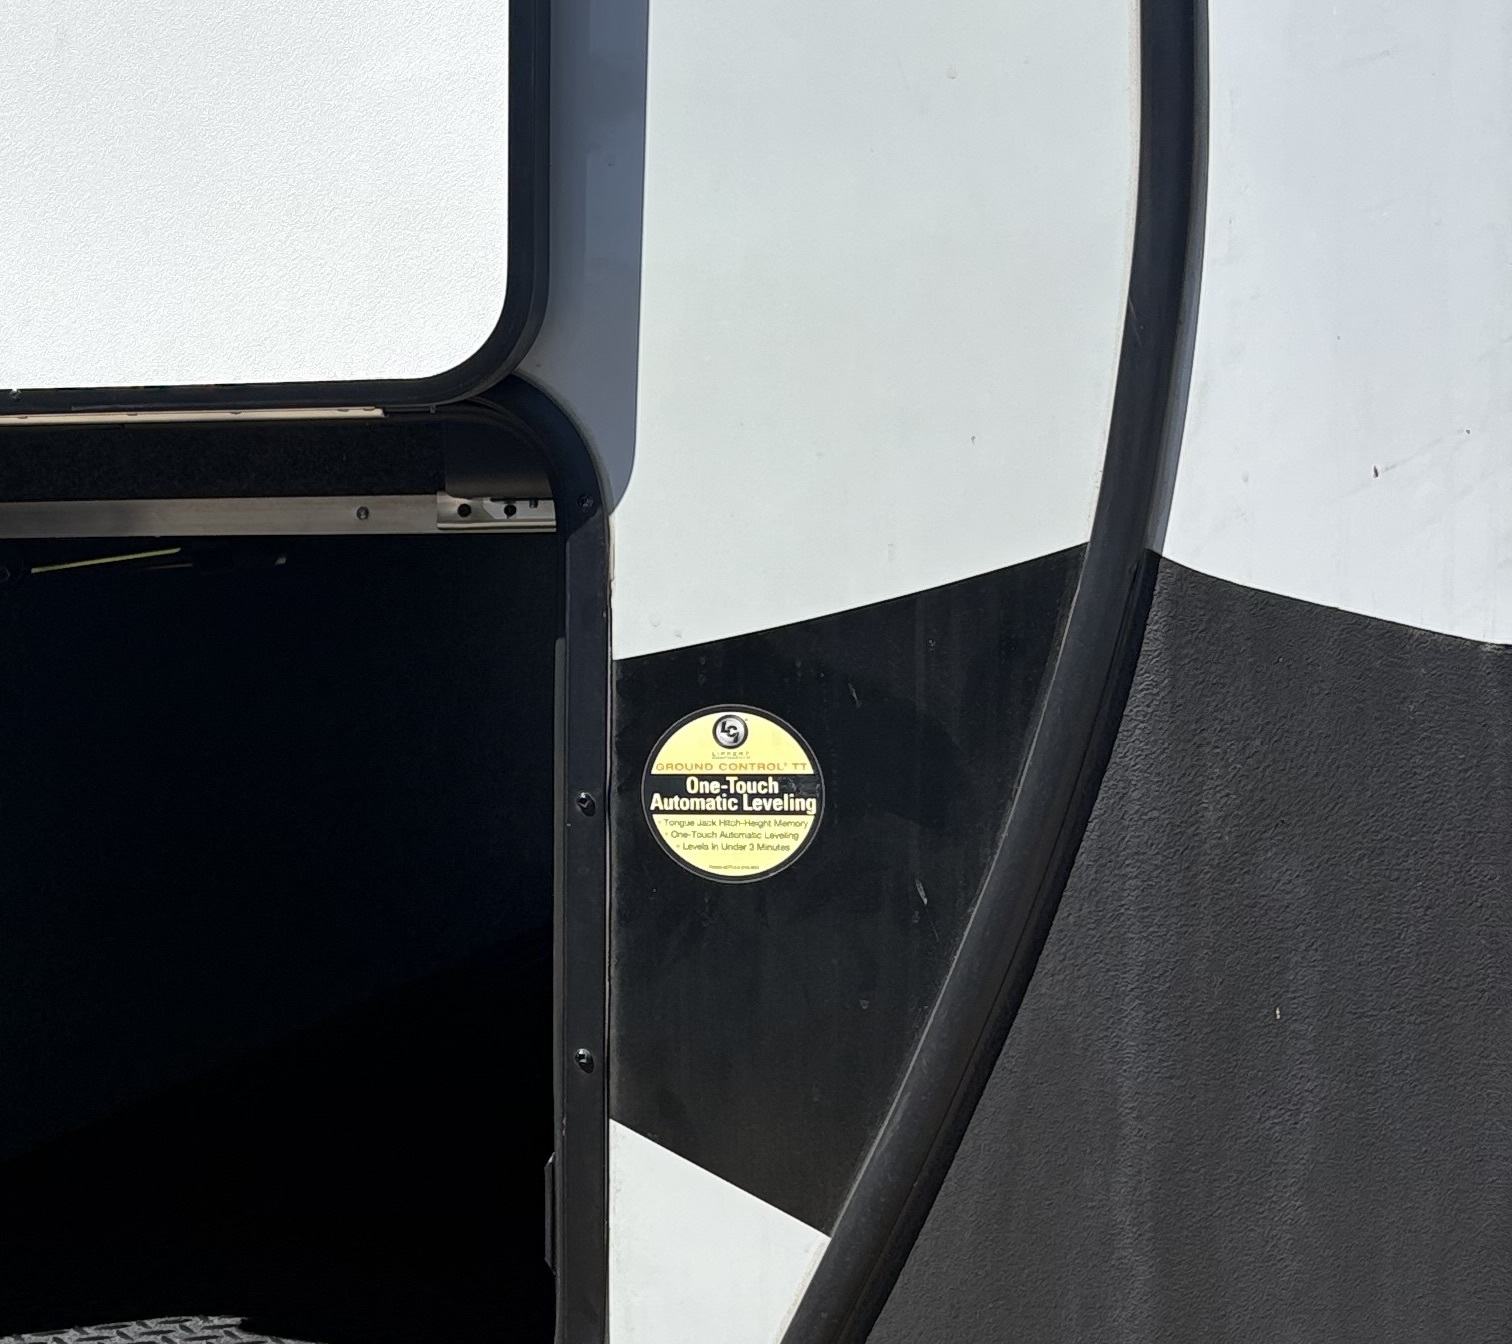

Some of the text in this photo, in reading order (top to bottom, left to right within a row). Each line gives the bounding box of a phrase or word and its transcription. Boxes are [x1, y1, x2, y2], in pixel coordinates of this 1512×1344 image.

[655, 762, 713, 771] GROUND
[791, 762, 808, 771] TT
[685, 776, 779, 794] One-Touch
[650, 793, 817, 814] Automatic Leveling
[664, 818, 695, 828] Tongue
[696, 818, 717, 827] Jack
[773, 819, 809, 829] Memory
[670, 830, 800, 842] One-Touch Automatic Leveling
[682, 842, 791, 852] Levels In Under 3 Minutes
